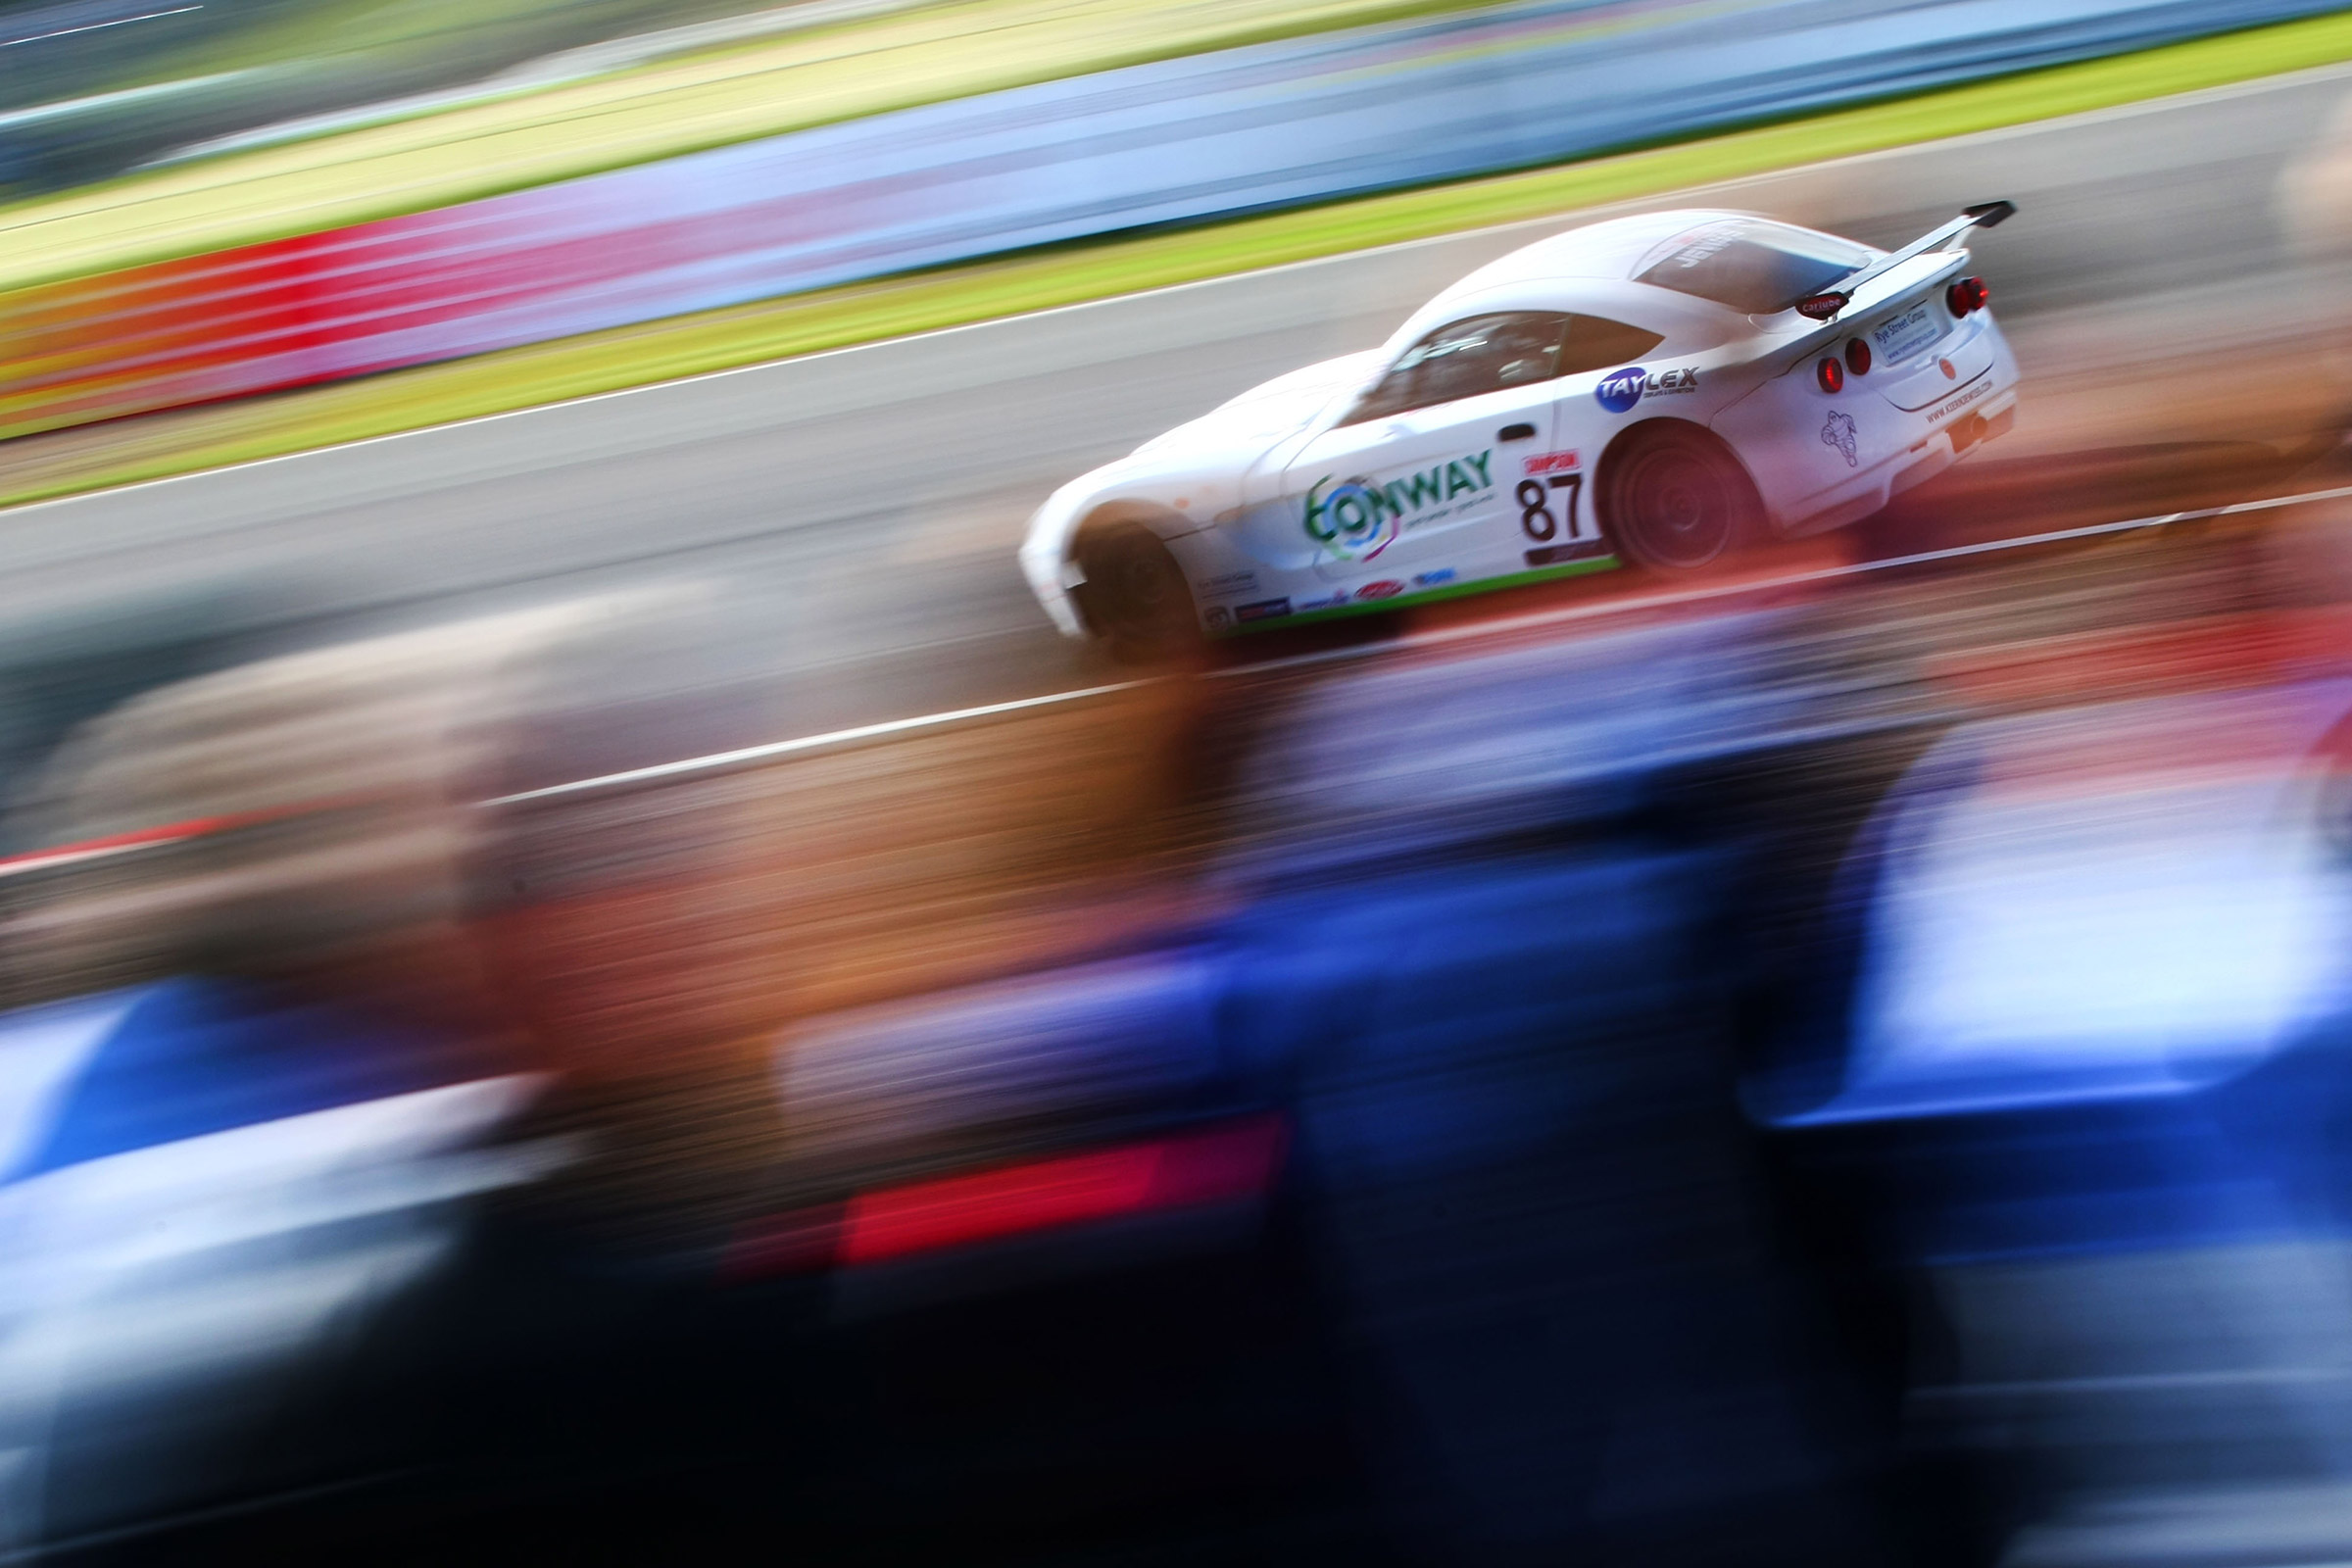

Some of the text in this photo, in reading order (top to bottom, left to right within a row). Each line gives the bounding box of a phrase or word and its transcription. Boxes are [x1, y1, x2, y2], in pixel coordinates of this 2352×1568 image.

[1874, 330, 1890, 344] Rye
[1887, 318, 1910, 336] Street
[1599, 367, 1700, 398] TAYLEX
[1515, 472, 1584, 544] 87
